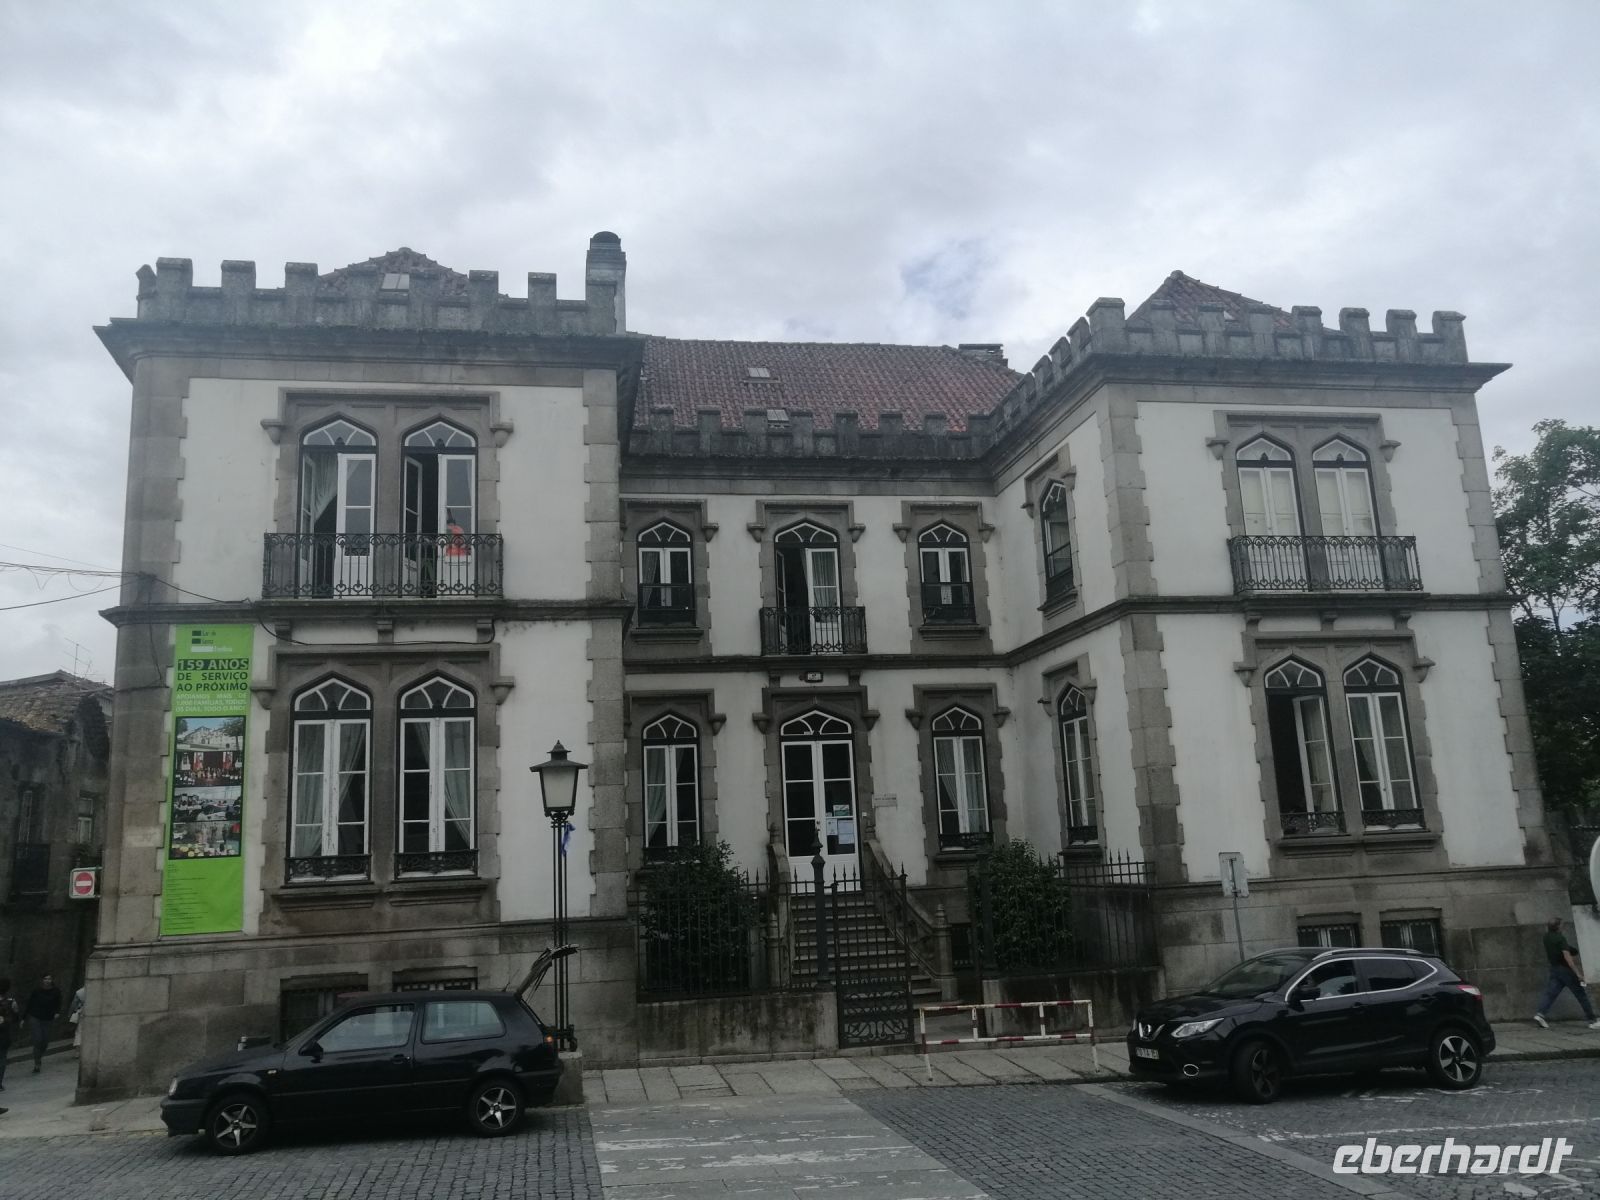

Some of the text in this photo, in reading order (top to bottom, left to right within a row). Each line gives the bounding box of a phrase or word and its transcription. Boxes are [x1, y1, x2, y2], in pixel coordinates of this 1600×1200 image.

[179, 659, 248, 670] 159 ANOS
[177, 672, 248, 682] DE SERVIÇO
[177, 682, 248, 691] AO PRÓXIMO
